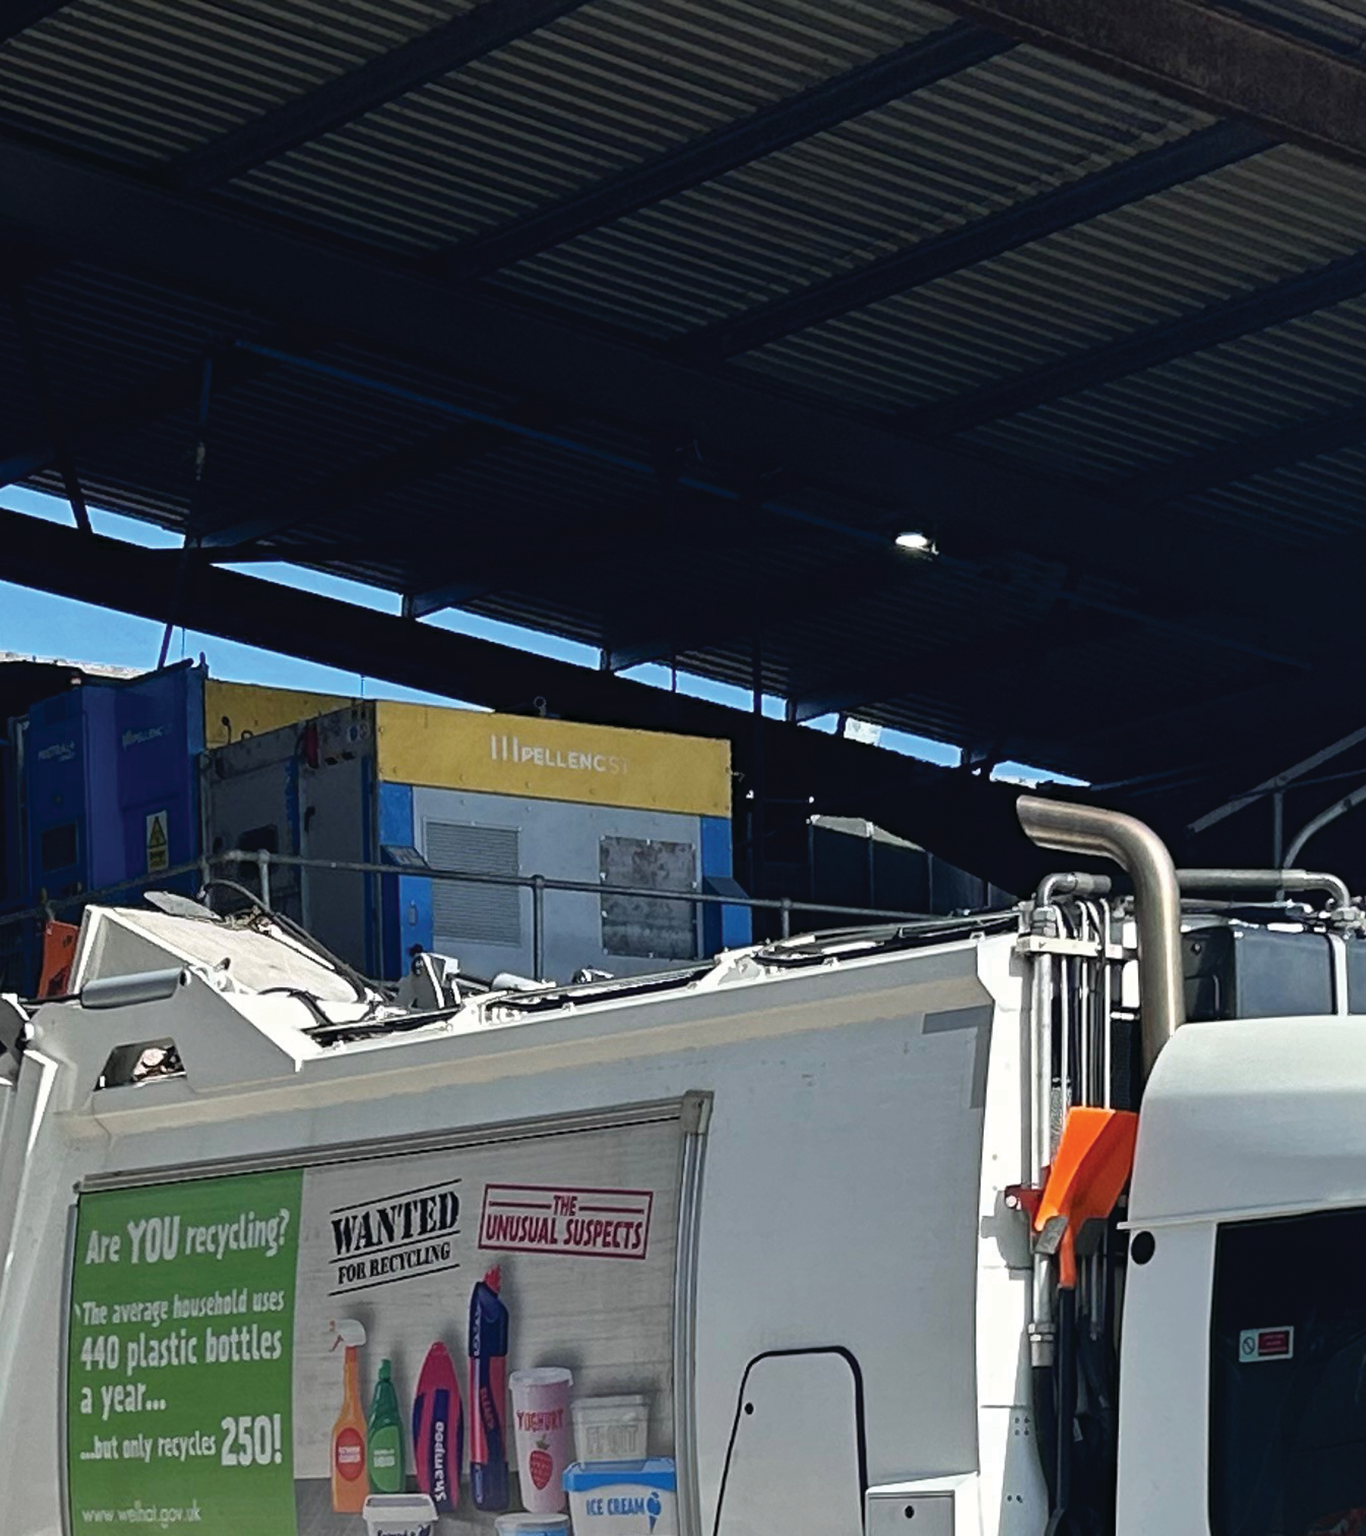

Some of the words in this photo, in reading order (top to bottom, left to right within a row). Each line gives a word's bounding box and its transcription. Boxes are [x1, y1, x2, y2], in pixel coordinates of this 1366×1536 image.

[521, 746, 607, 773] PELLENC
[330, 1190, 461, 1256] WANTED
[553, 1194, 578, 1217] THE
[85, 1229, 121, 1265] Are
[126, 1215, 181, 1265] YOU
[185, 1207, 291, 1260] recycling?
[486, 1214, 558, 1245] UNUSUAL
[563, 1218, 643, 1250] SUSPECTS
[337, 1263, 367, 1285] FOR
[369, 1241, 452, 1278] RECYCLING
[82, 1300, 108, 1326] The
[112, 1300, 169, 1328] average
[173, 1287, 248, 1319] household
[253, 1290, 285, 1312] uses
[80, 1334, 120, 1372] 440
[126, 1328, 198, 1377] plastic
[205, 1323, 283, 1364] bottles
[80, 1386, 93, 1415] a
[101, 1382, 167, 1422] year...
[516, 1409, 565, 1432] YOGHURT
[123, 1433, 153, 1464] only
[158, 1430, 217, 1462] recycles
[220, 1413, 283, 1467] 250!
[434, 1421, 447, 1502] Shampoo
[585, 1496, 604, 1516] ICE
[607, 1496, 646, 1516] CREAM
